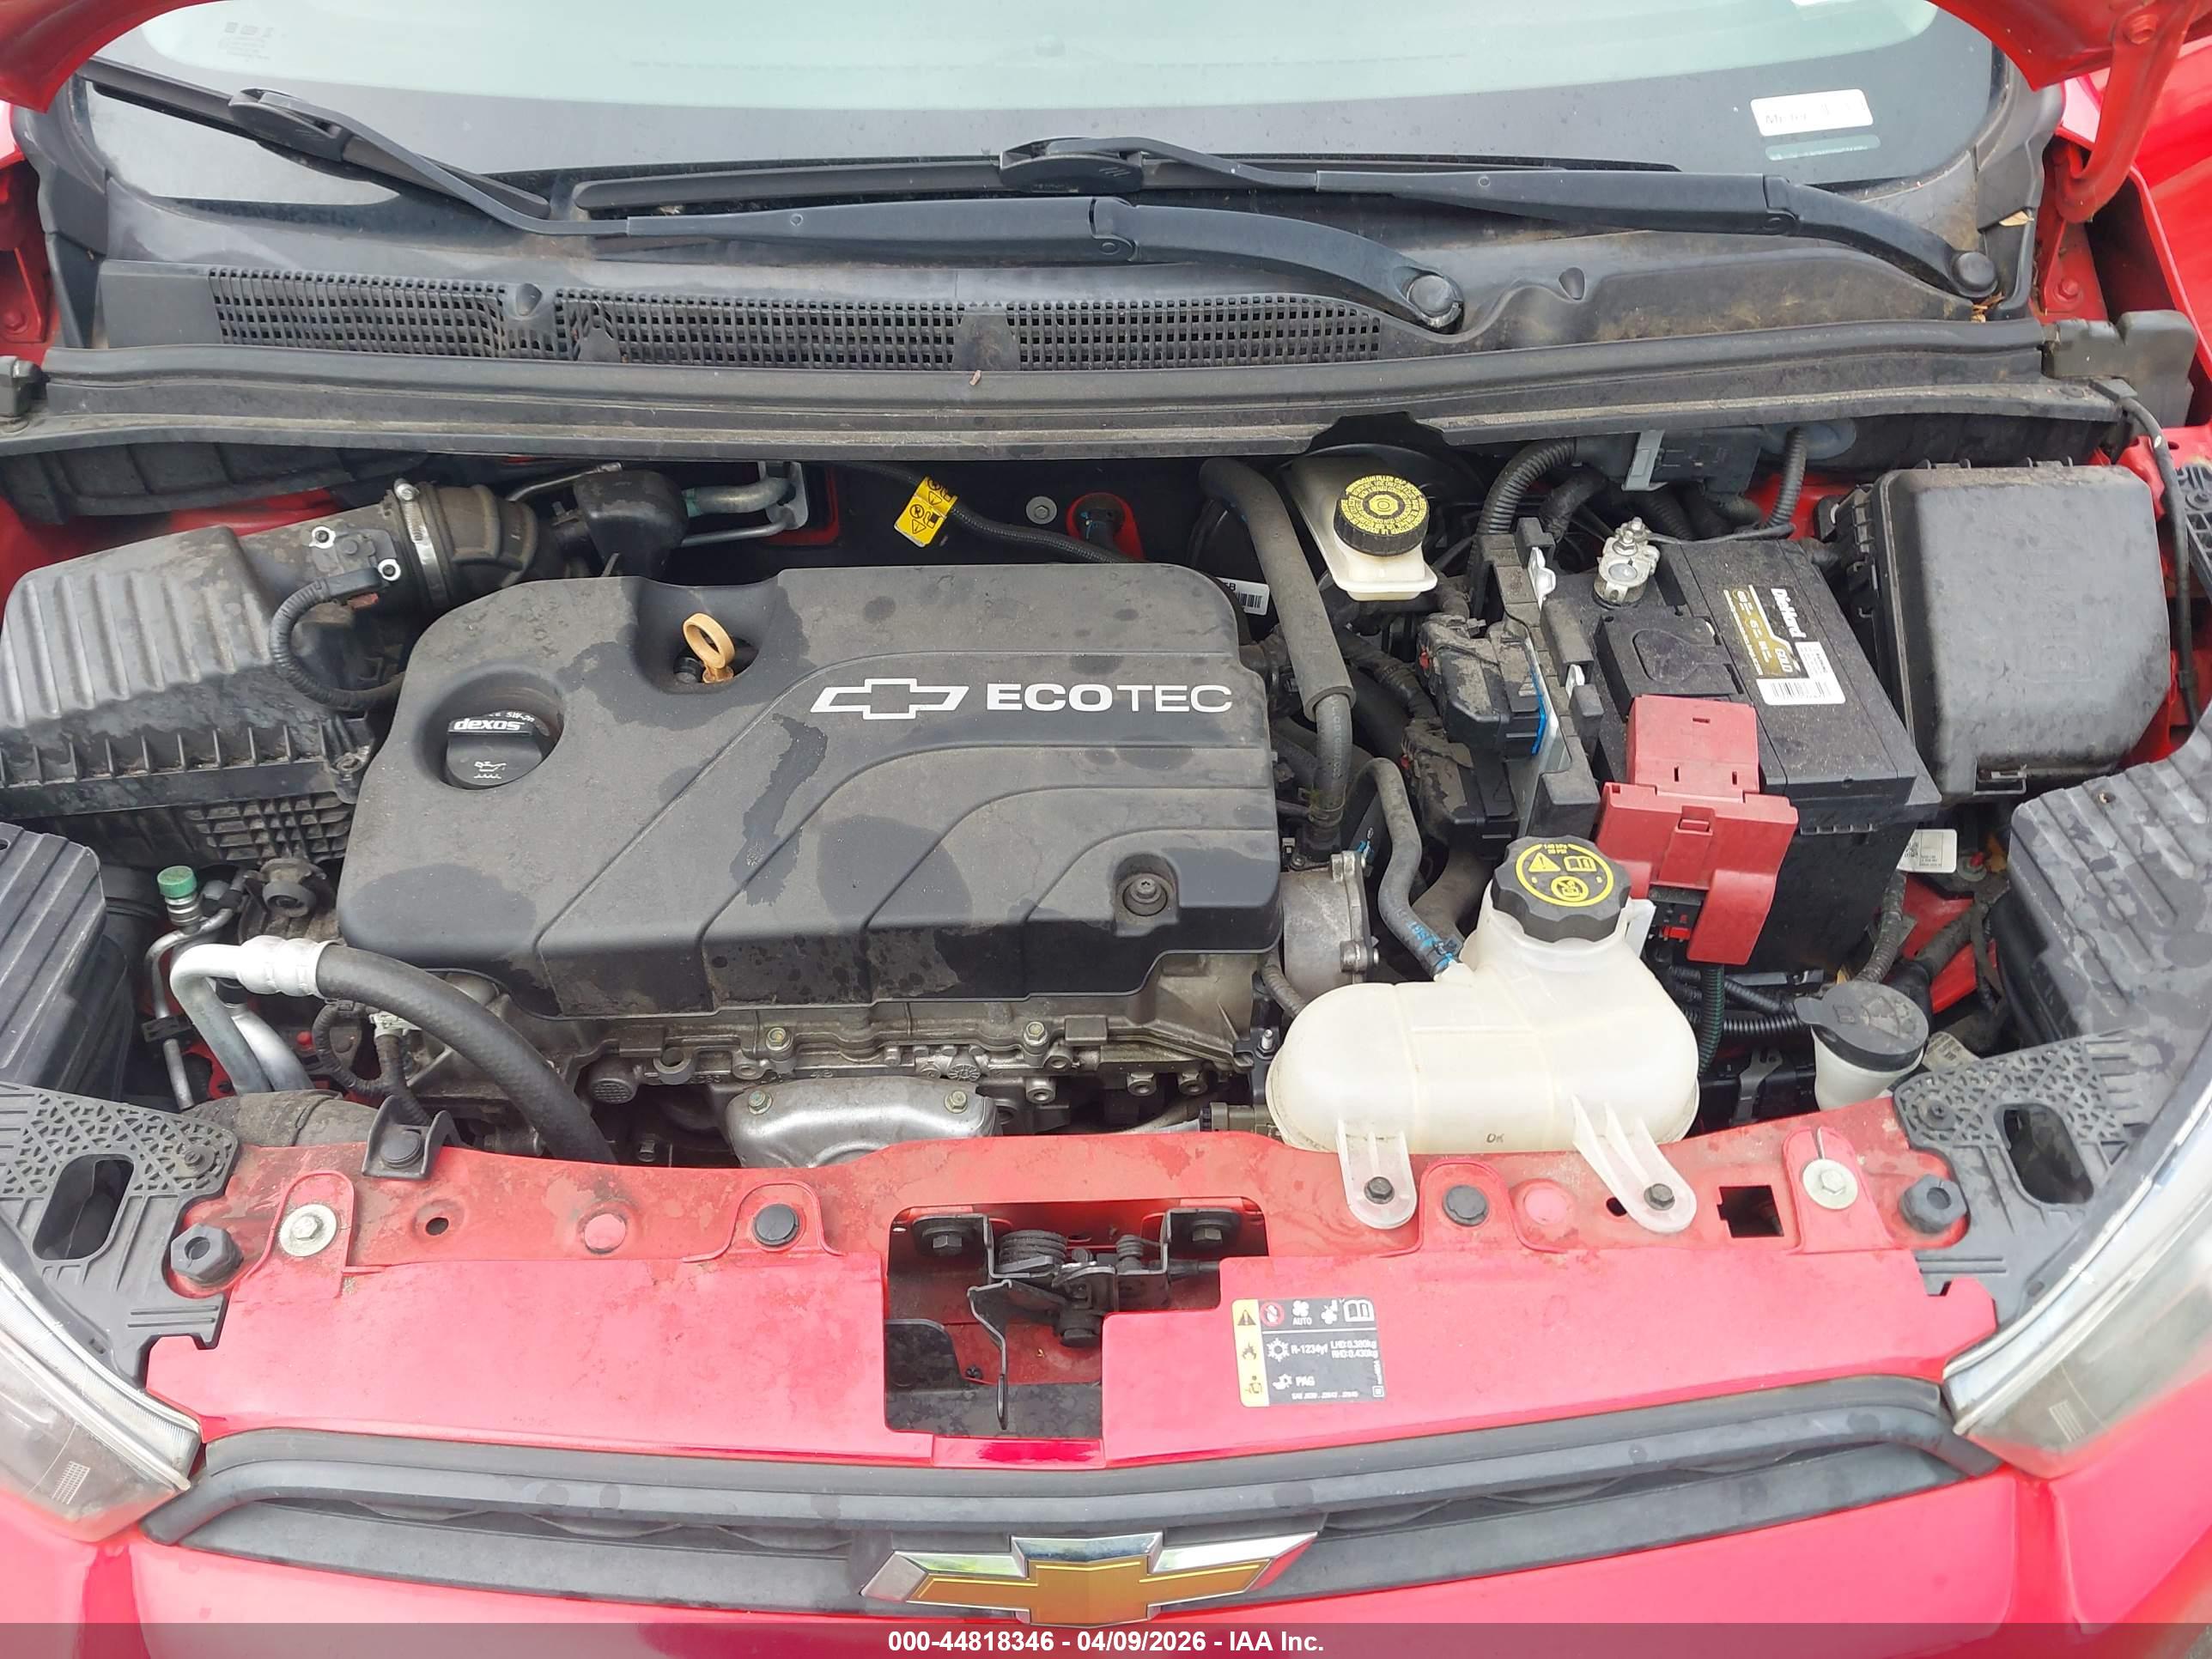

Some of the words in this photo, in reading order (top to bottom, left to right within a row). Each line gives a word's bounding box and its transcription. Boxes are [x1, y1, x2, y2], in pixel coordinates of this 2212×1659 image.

[1770, 588, 1807, 638] DieHard
[1774, 647, 1793, 672] GOLD
[987, 683, 1233, 713] ECOTEC
[453, 718, 526, 731] dexos
[1292, 1317, 1313, 1326] AUTO
[1291, 1343, 1328, 1356] R-1234yf
[1295, 1376, 1316, 1387] PAG
